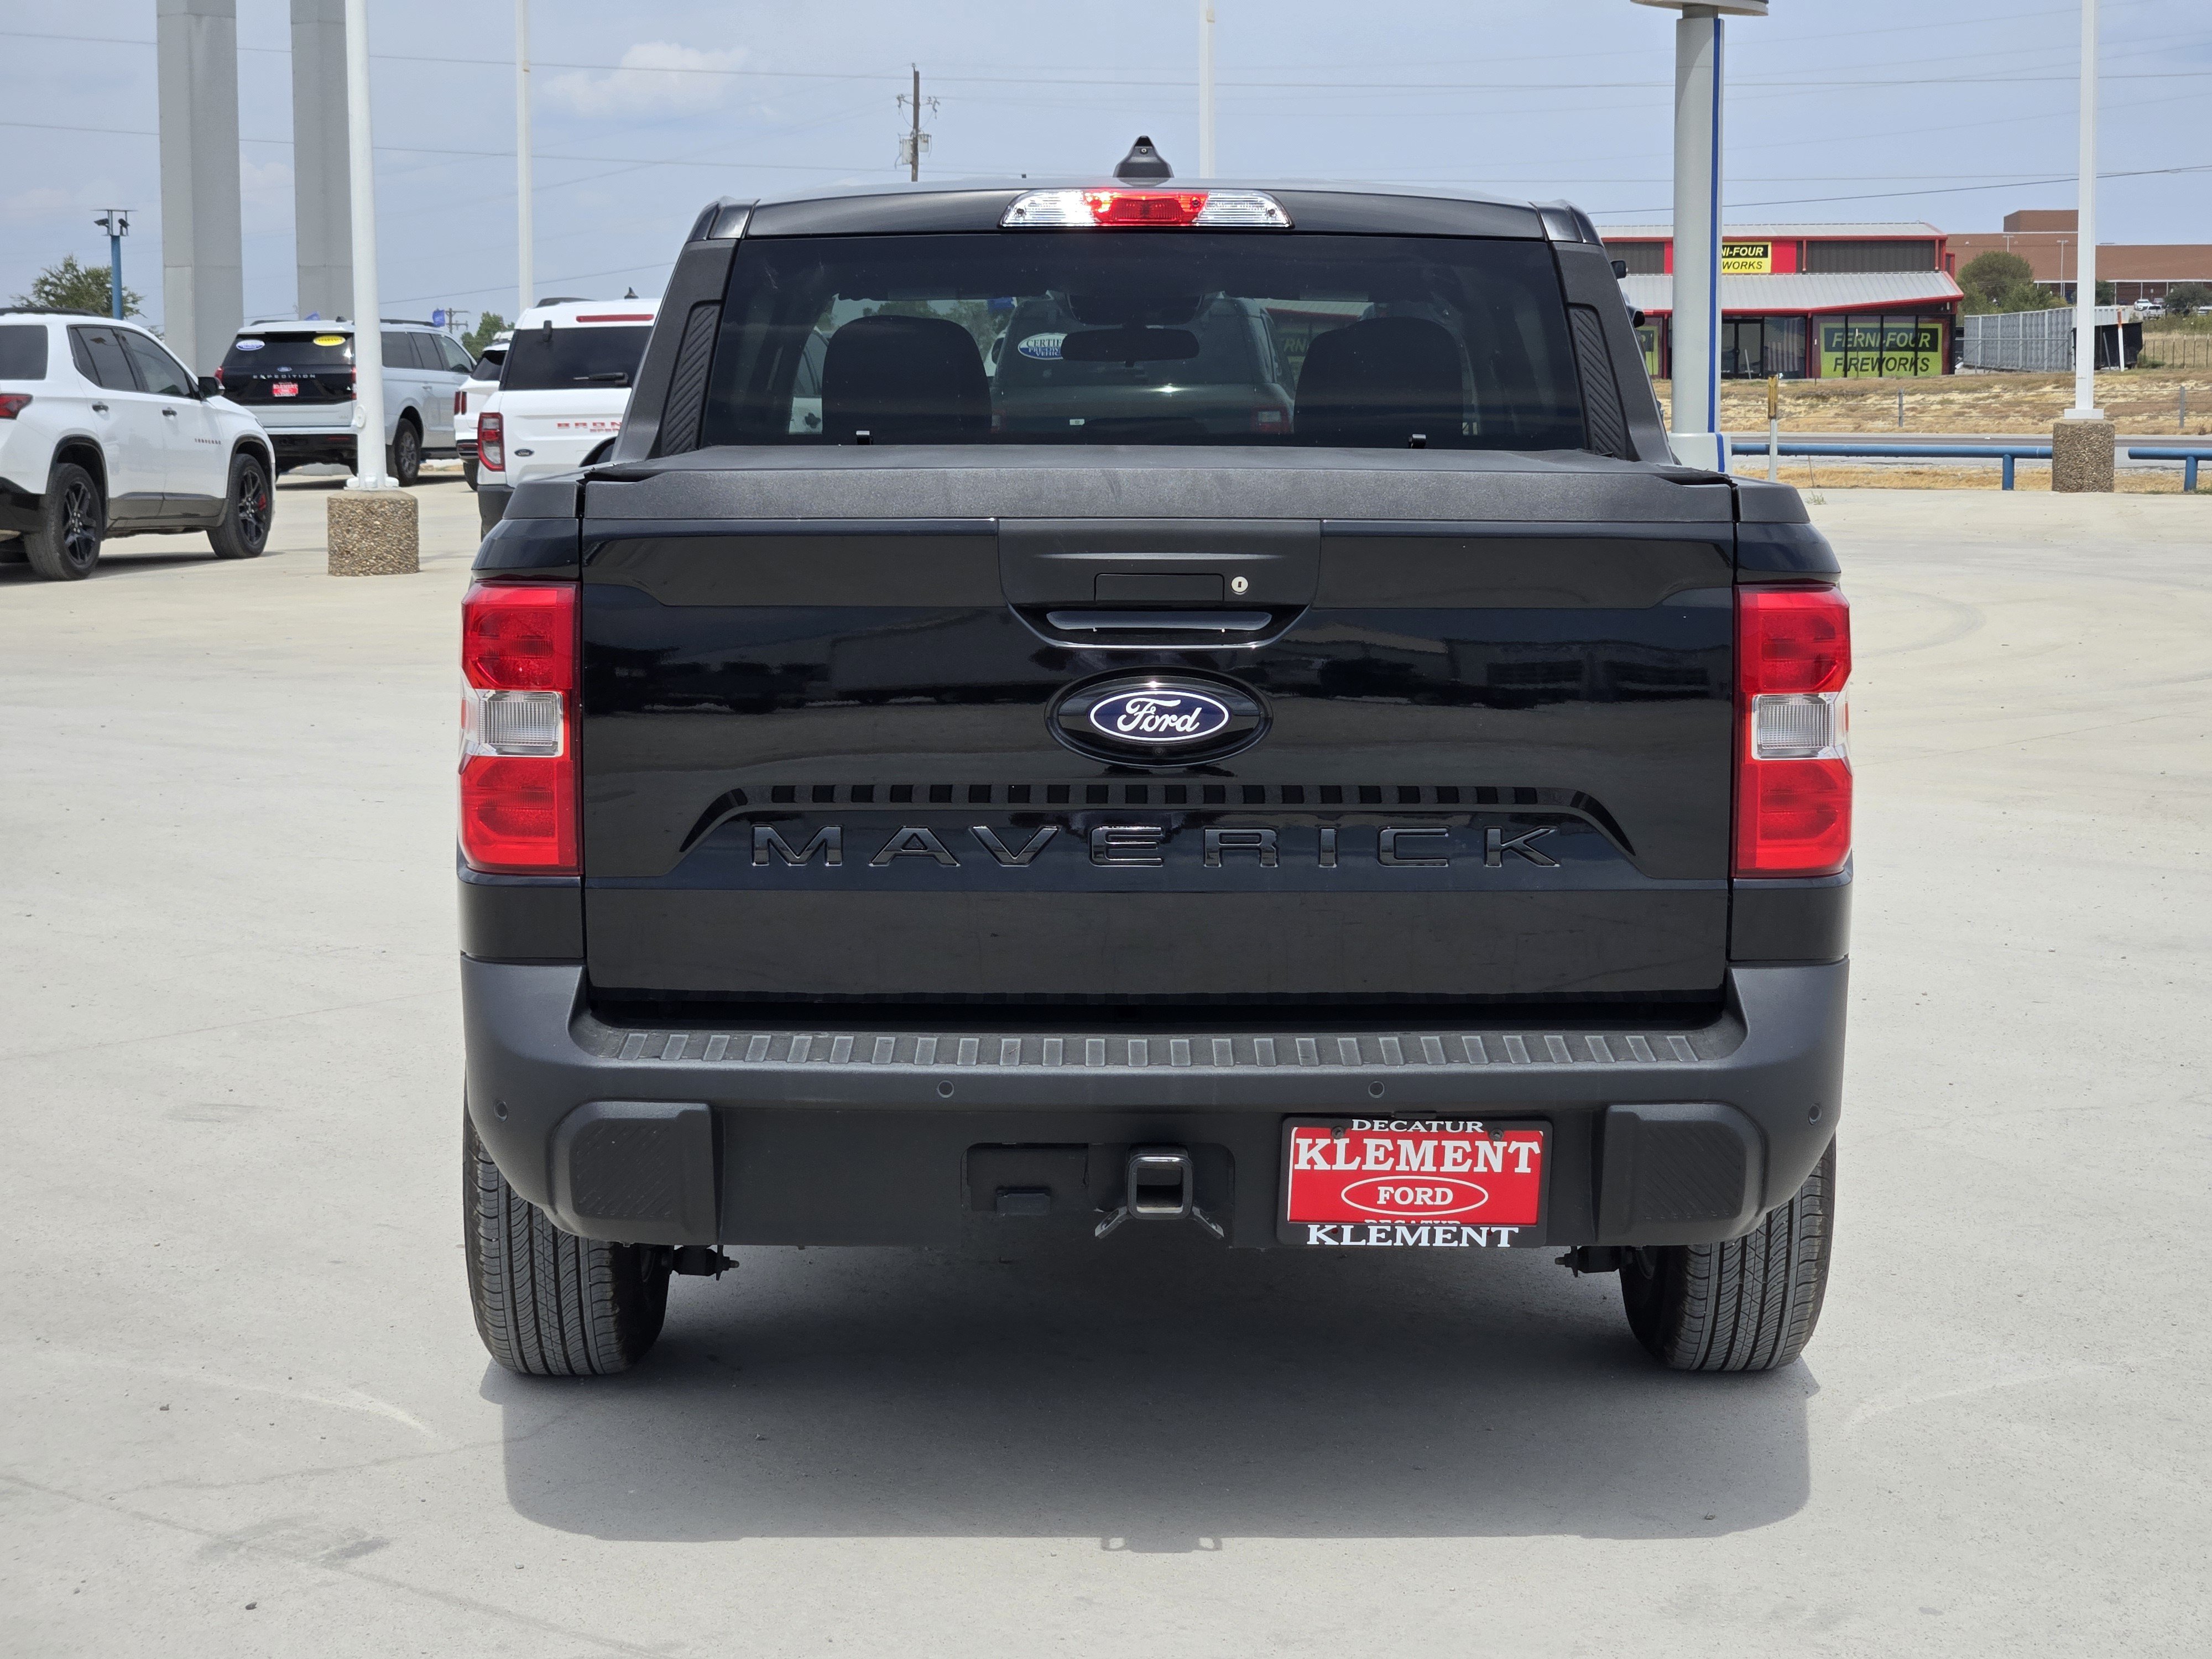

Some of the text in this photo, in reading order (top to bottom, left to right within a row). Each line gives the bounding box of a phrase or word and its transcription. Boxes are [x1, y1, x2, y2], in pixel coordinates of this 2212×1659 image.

[1723, 261, 1762, 270] WORKS
[1833, 357, 1930, 372] FREWORKS
[1117, 697, 1203, 733] Ford
[752, 824, 1561, 868] MAVERICK
[1352, 1119, 1484, 1134] DECATUR
[1294, 1138, 1541, 1173] KLEMENT
[1376, 1186, 1454, 1205] FORD
[1307, 1224, 1519, 1248] KLEMENT
